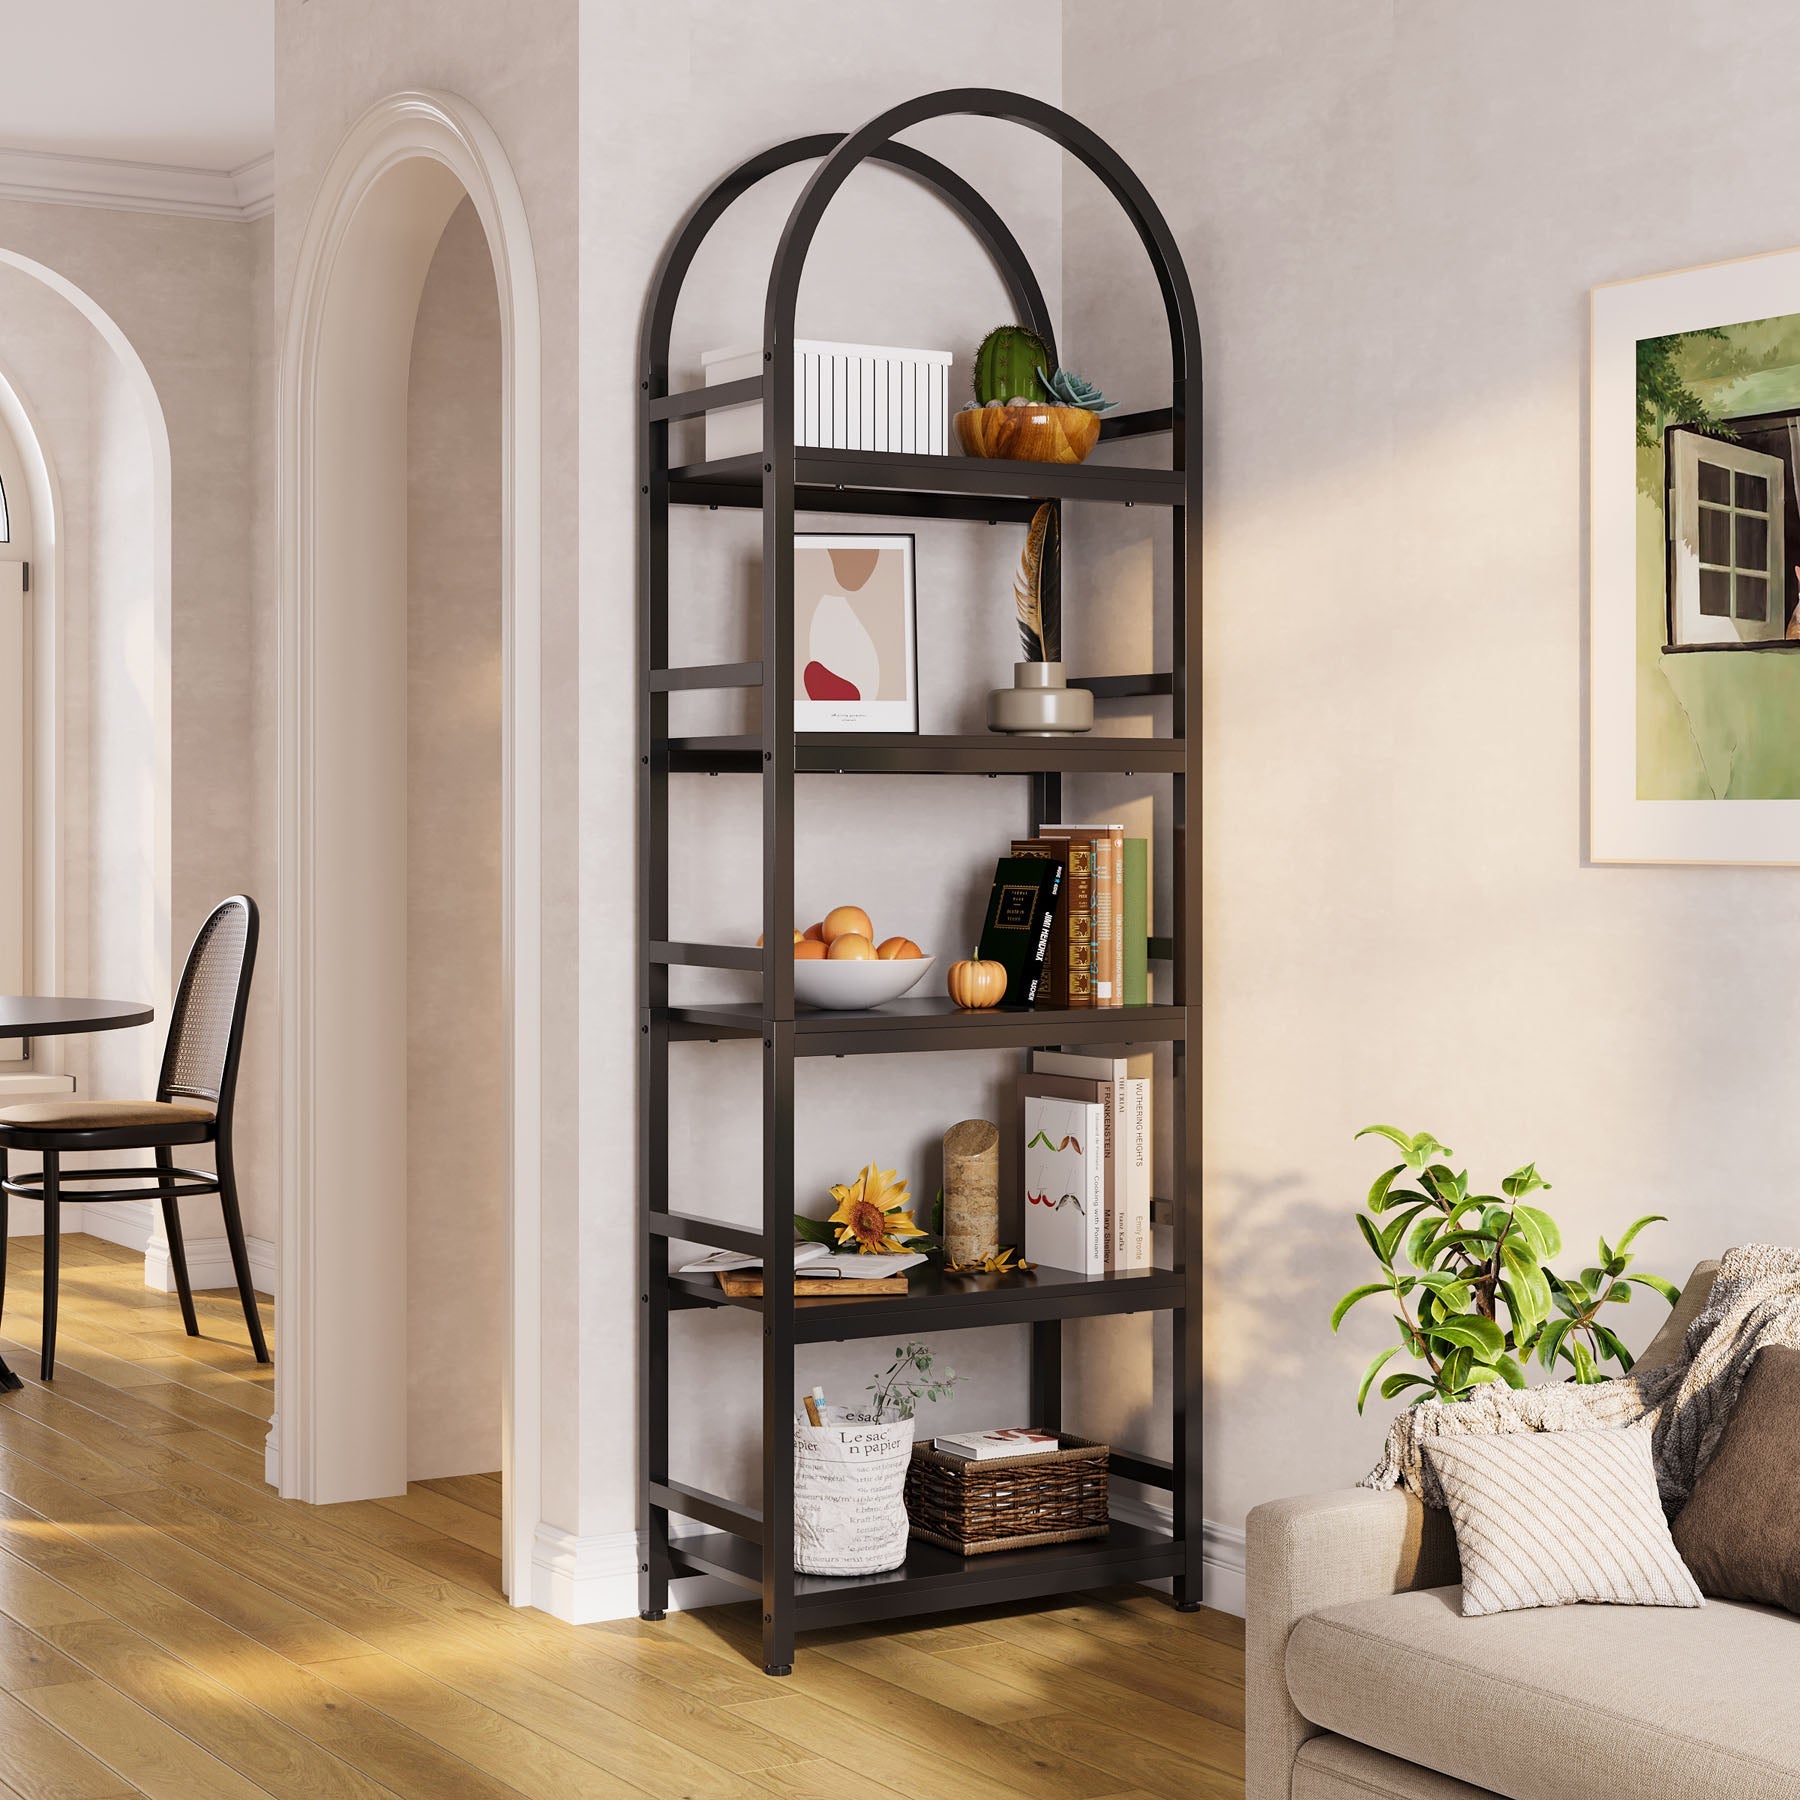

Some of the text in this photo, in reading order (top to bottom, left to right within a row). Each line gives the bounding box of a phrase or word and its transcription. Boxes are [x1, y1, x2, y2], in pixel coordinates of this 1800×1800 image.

[1035, 911, 1053, 962] JIMI HENDRIX
[1135, 1082, 1143, 1167] WUTHERING HEIGHTS
[1103, 1209, 1111, 1264] Mary Shelley
[1135, 1215, 1143, 1236] Emily
[840, 1432, 863, 1444] Le
[864, 1439, 903, 1457] papier
